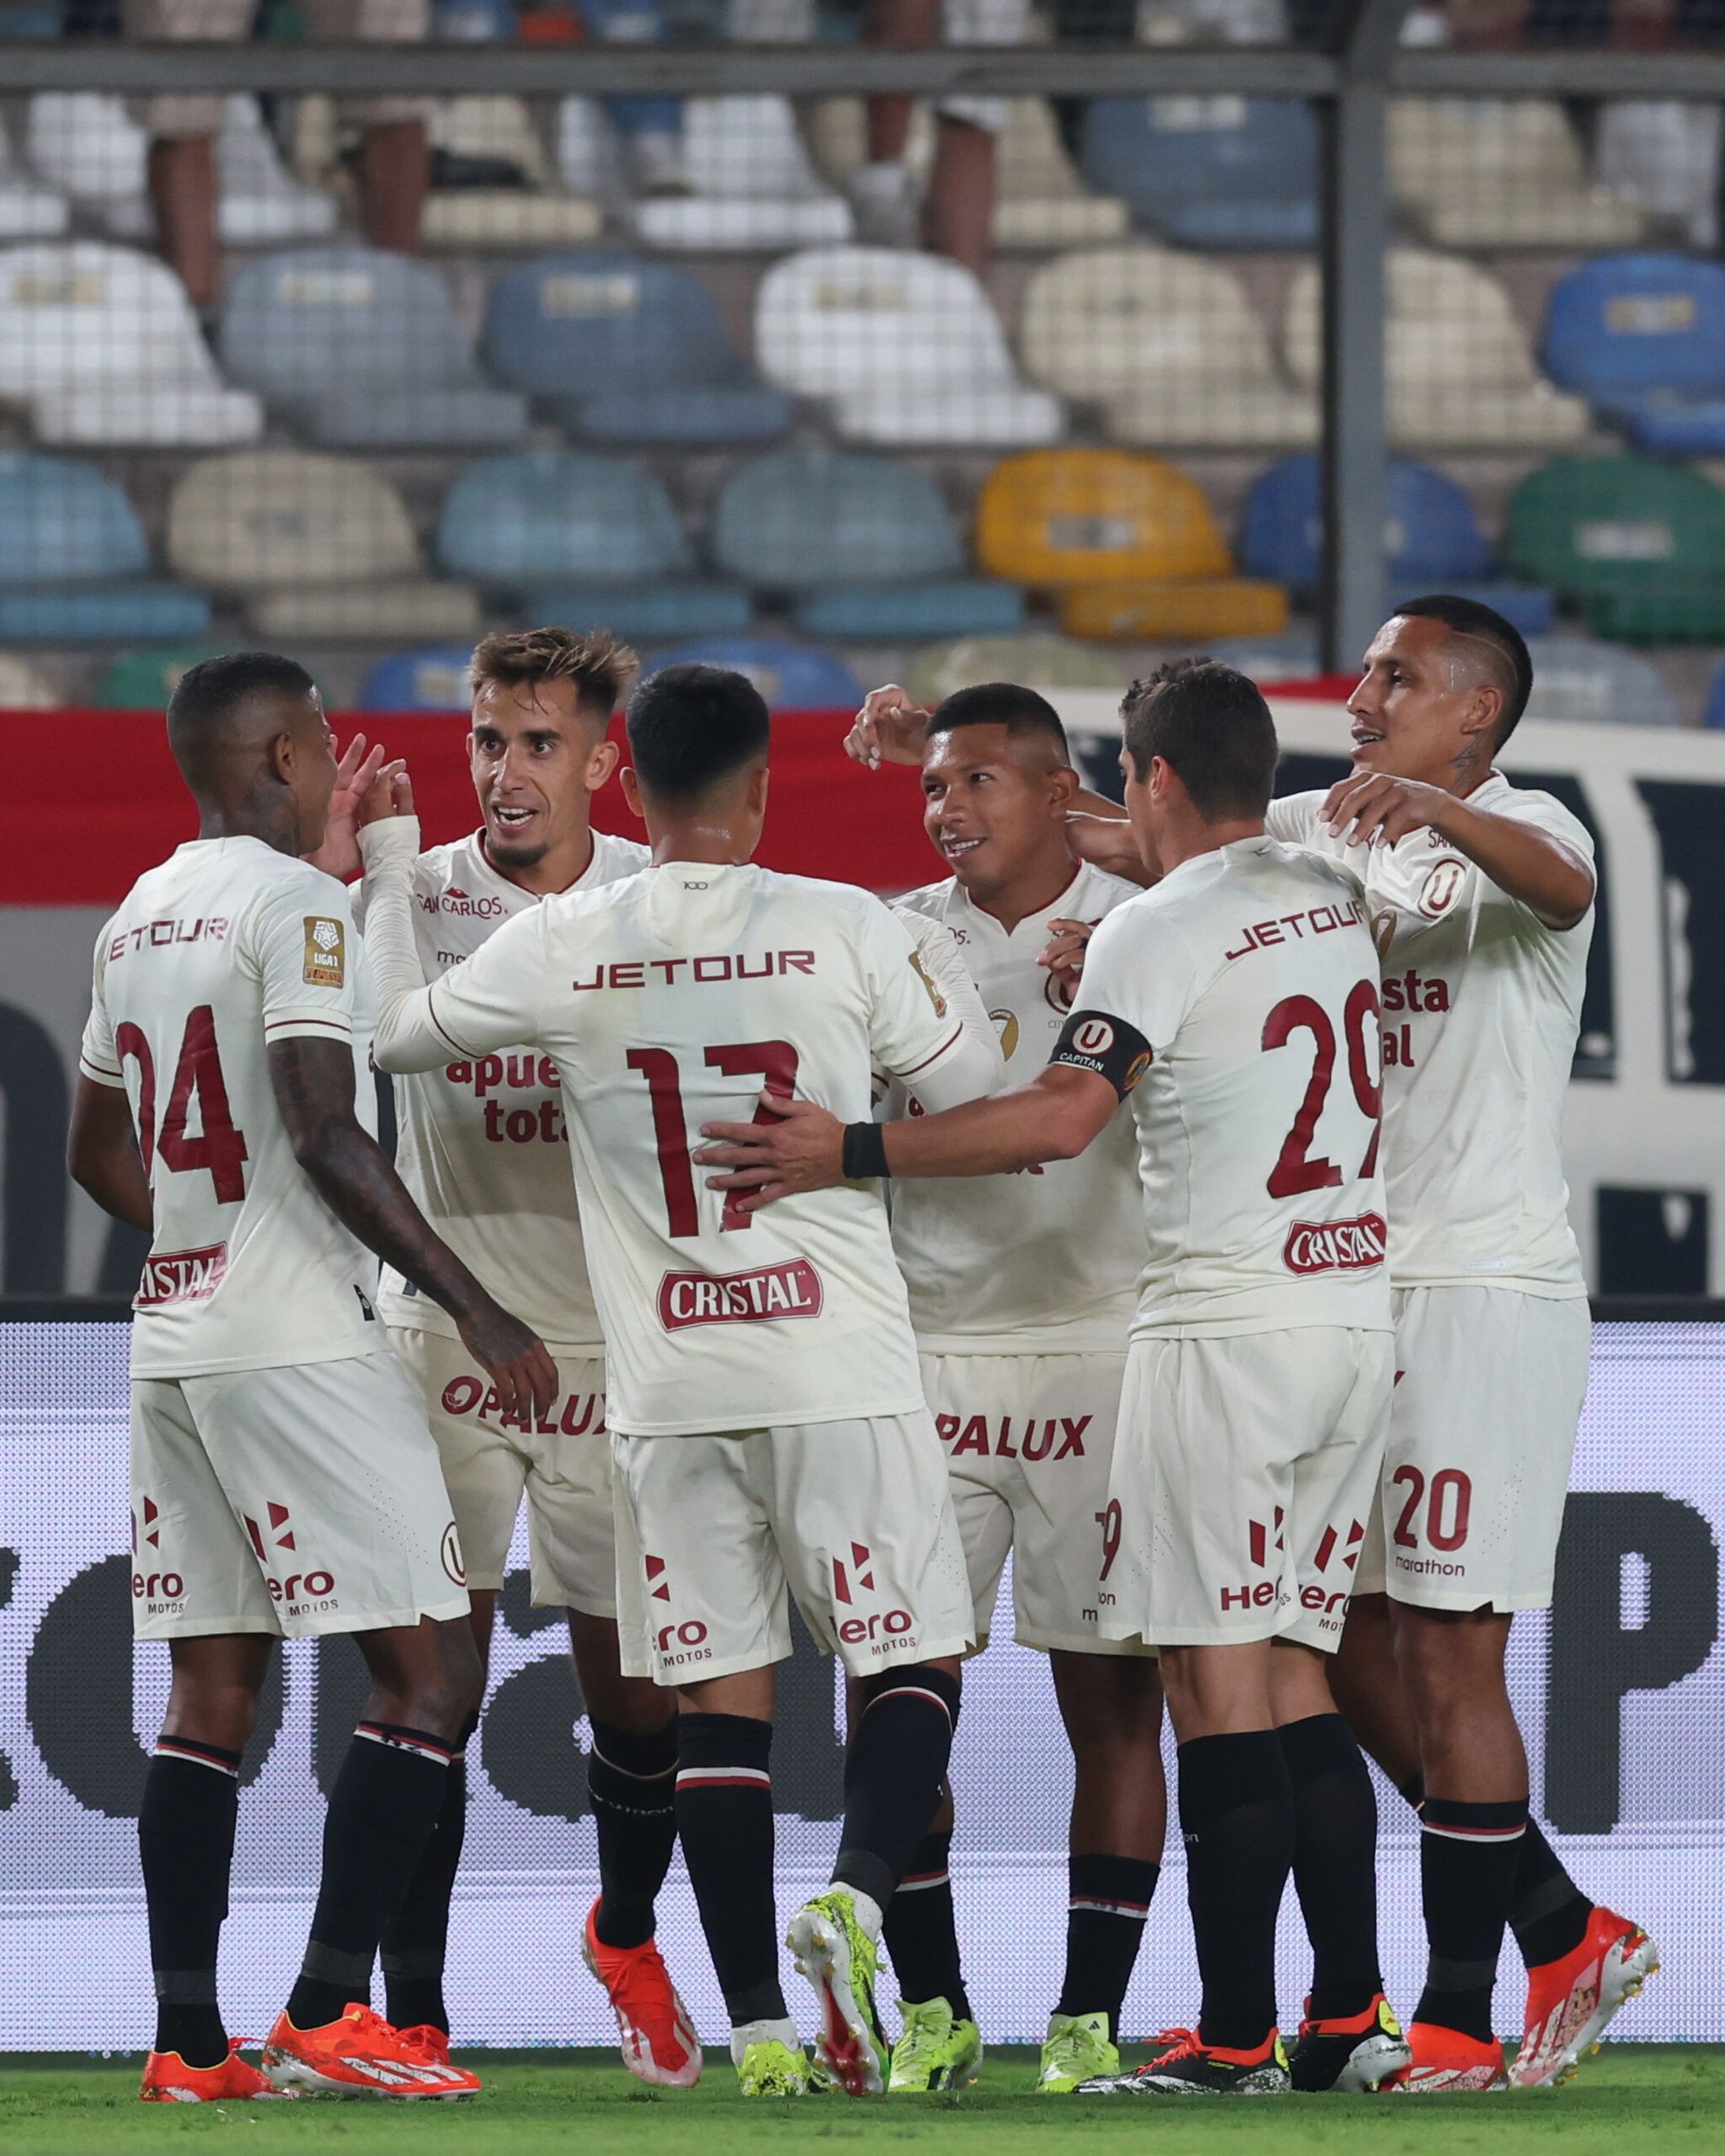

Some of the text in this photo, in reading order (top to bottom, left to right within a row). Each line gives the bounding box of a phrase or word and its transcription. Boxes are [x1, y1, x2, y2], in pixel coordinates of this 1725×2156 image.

[682, 881, 708, 890] 100
[573, 950, 816, 991] JETOUR
[1080, 1024, 1107, 1049] U
[1060, 1052, 1104, 1071] CAPITAN
[1261, 979, 1381, 1199] 29
[483, 1099, 569, 1143] tot
[626, 1039, 799, 1238] 17
[670, 1272, 812, 1319] CRISTAL
[1393, 1465, 1471, 1552] 20
[1396, 1556, 1465, 1577] marathon
[147, 1602, 185, 1614] MOTOS
[289, 1598, 339, 1617] MOTOS
[829, 1609, 912, 1645] ero
[663, 1648, 713, 1668] MOTOS
[871, 1636, 916, 1656] MOTOS
